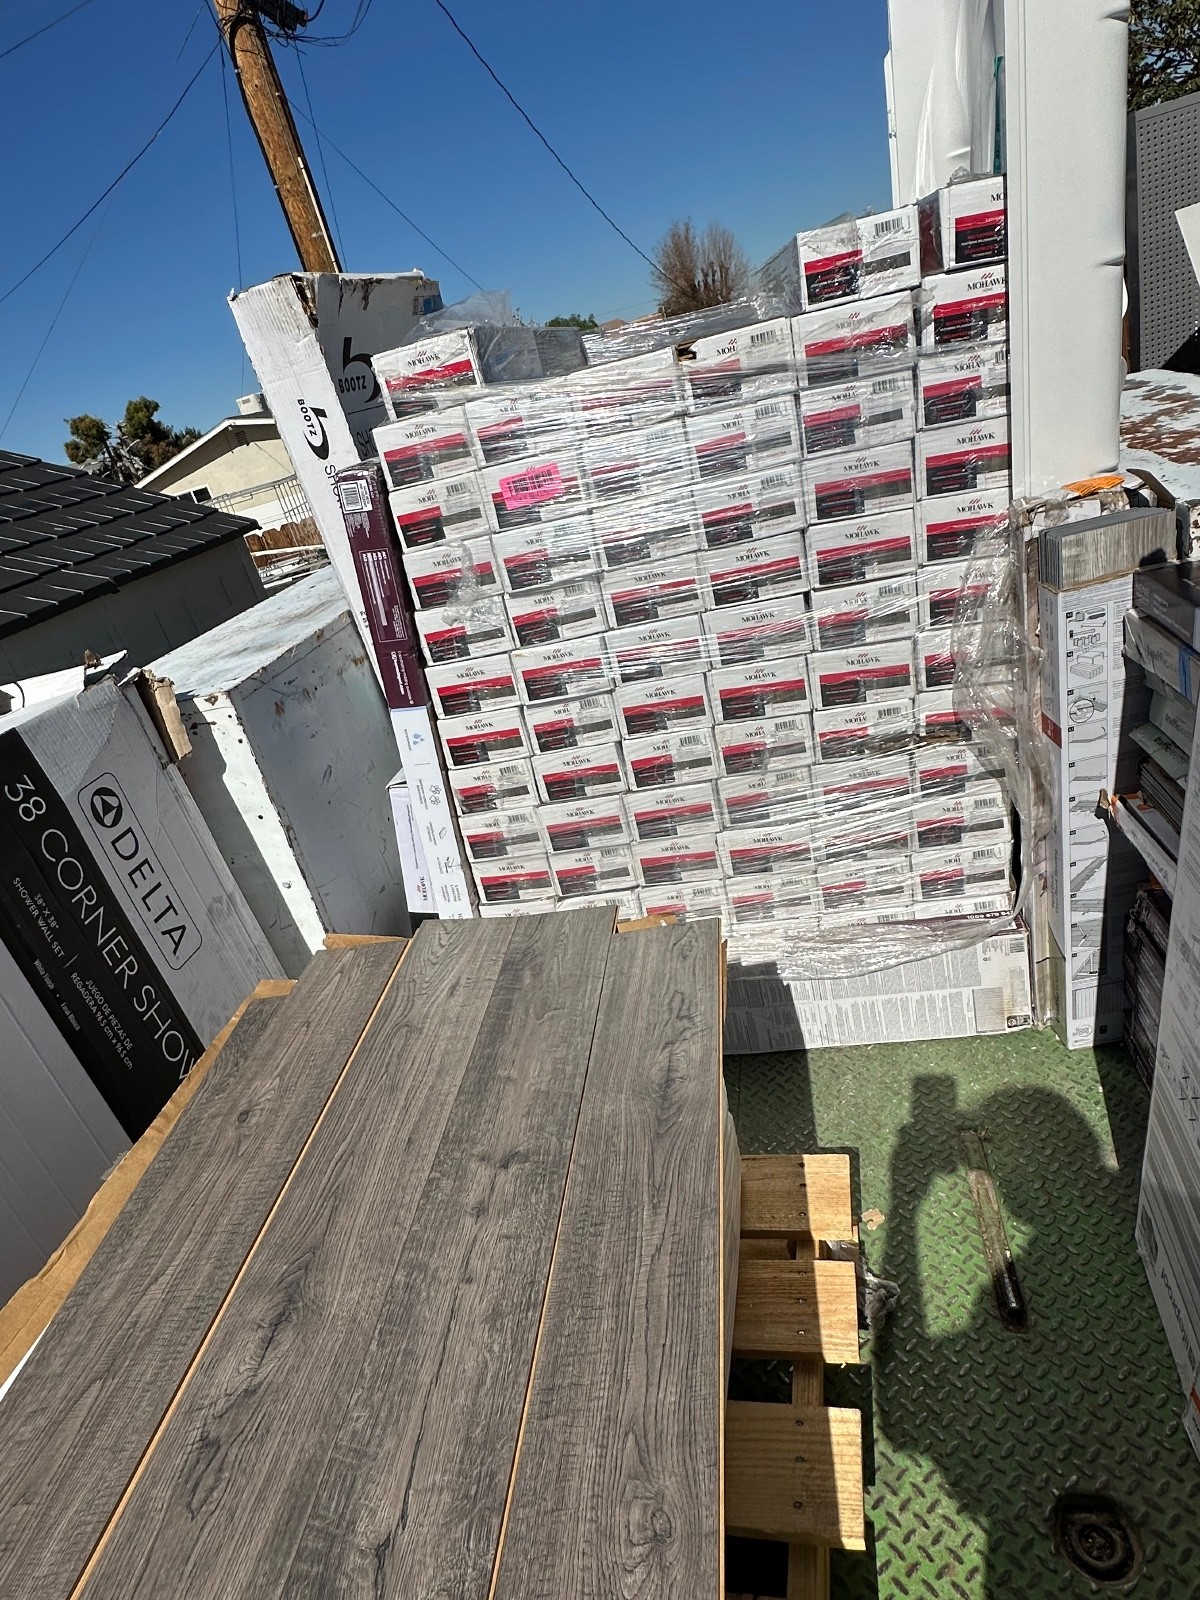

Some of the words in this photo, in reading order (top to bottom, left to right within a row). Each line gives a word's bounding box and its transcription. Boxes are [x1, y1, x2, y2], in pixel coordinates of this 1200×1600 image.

[716, 345, 738, 356] MOH
[407, 353, 441, 367] MOHAWK
[955, 361, 983, 372] MOHA
[338, 375, 367, 394] BOOTZ
[297, 398, 318, 437] BOOTZ
[405, 426, 437, 440] MOHAWK
[957, 432, 995, 445] MOHAWK
[843, 459, 880, 472] MOHAWK
[957, 502, 994, 514] MOHAWK
[845, 528, 880, 540] MOHAWK
[735, 551, 770, 563] MOHAWK
[634, 572, 666, 583] MOHAWK
[741, 613, 775, 623] MOHAWK
[638, 631, 670, 642] MOHAWK
[542, 651, 574, 661] MOHAWK
[846, 656, 881, 666] MOHAWK
[456, 669, 486, 679] MOHAWK
[744, 672, 776, 681] MOHAWK
[645, 689, 677, 699] MOHAWK
[465, 721, 494, 732] MOHAWK
[562, 758, 591, 767] MOHAWK
[111, 826, 189, 956] DELTA
[13, 877, 39, 918] SHOWER
[38, 917, 52, 942] WALL
[51, 941, 65, 957] SET
[4, 774, 46, 822] 38
[41, 829, 138, 989] CORNER
[134, 984, 195, 1080] SHOW
[70, 972, 98, 1014] REGADERA
[104, 1025, 114, 1040] cm
[124, 1057, 133, 1070] cm
[85, 979, 105, 1005] JUEGO
[101, 1003, 112, 1016] DE
[108, 1014, 127, 1040] PIEZAS
[124, 1038, 134, 1051] DE
